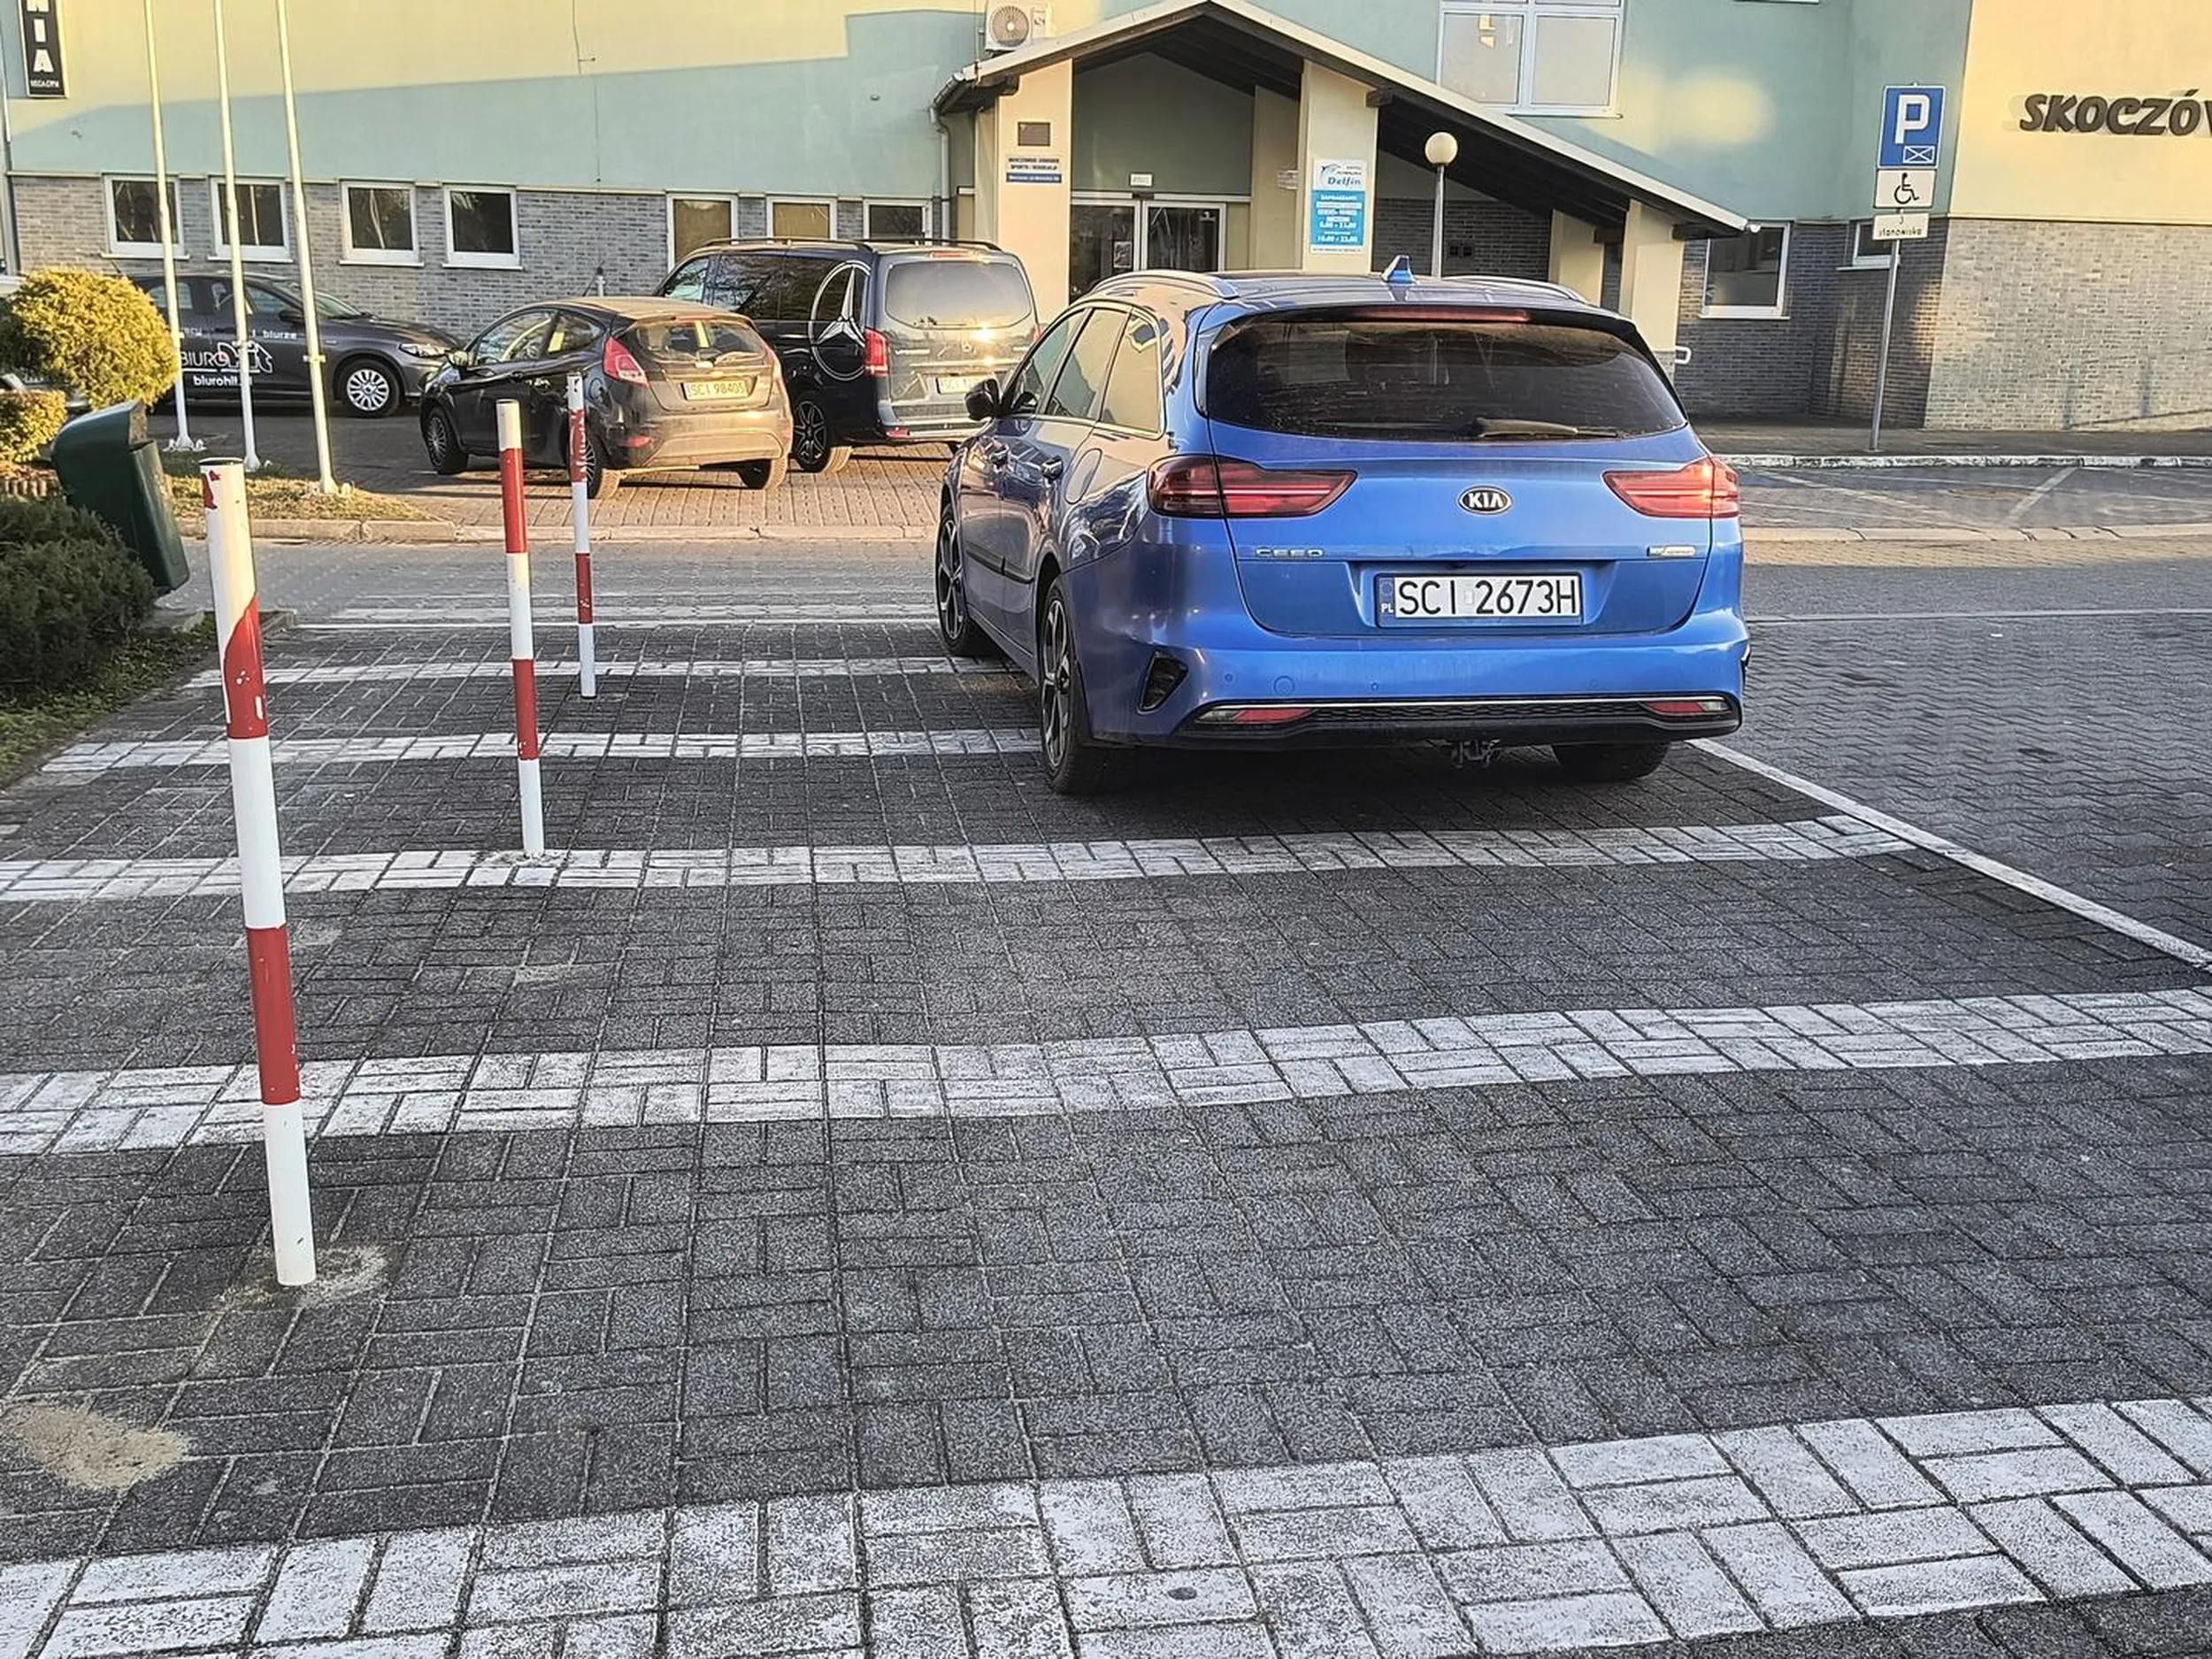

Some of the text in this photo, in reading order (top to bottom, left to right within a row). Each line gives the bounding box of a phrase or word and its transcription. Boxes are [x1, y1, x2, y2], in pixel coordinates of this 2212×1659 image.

[1895, 95, 1930, 144] P
[2019, 89, 2212, 136] SKOCZÓ
[1328, 177, 1361, 187] Delfin
[1469, 492, 1503, 508] KIA
[1381, 603, 1394, 612] PL
[1399, 580, 1577, 615] SCI 2673H
